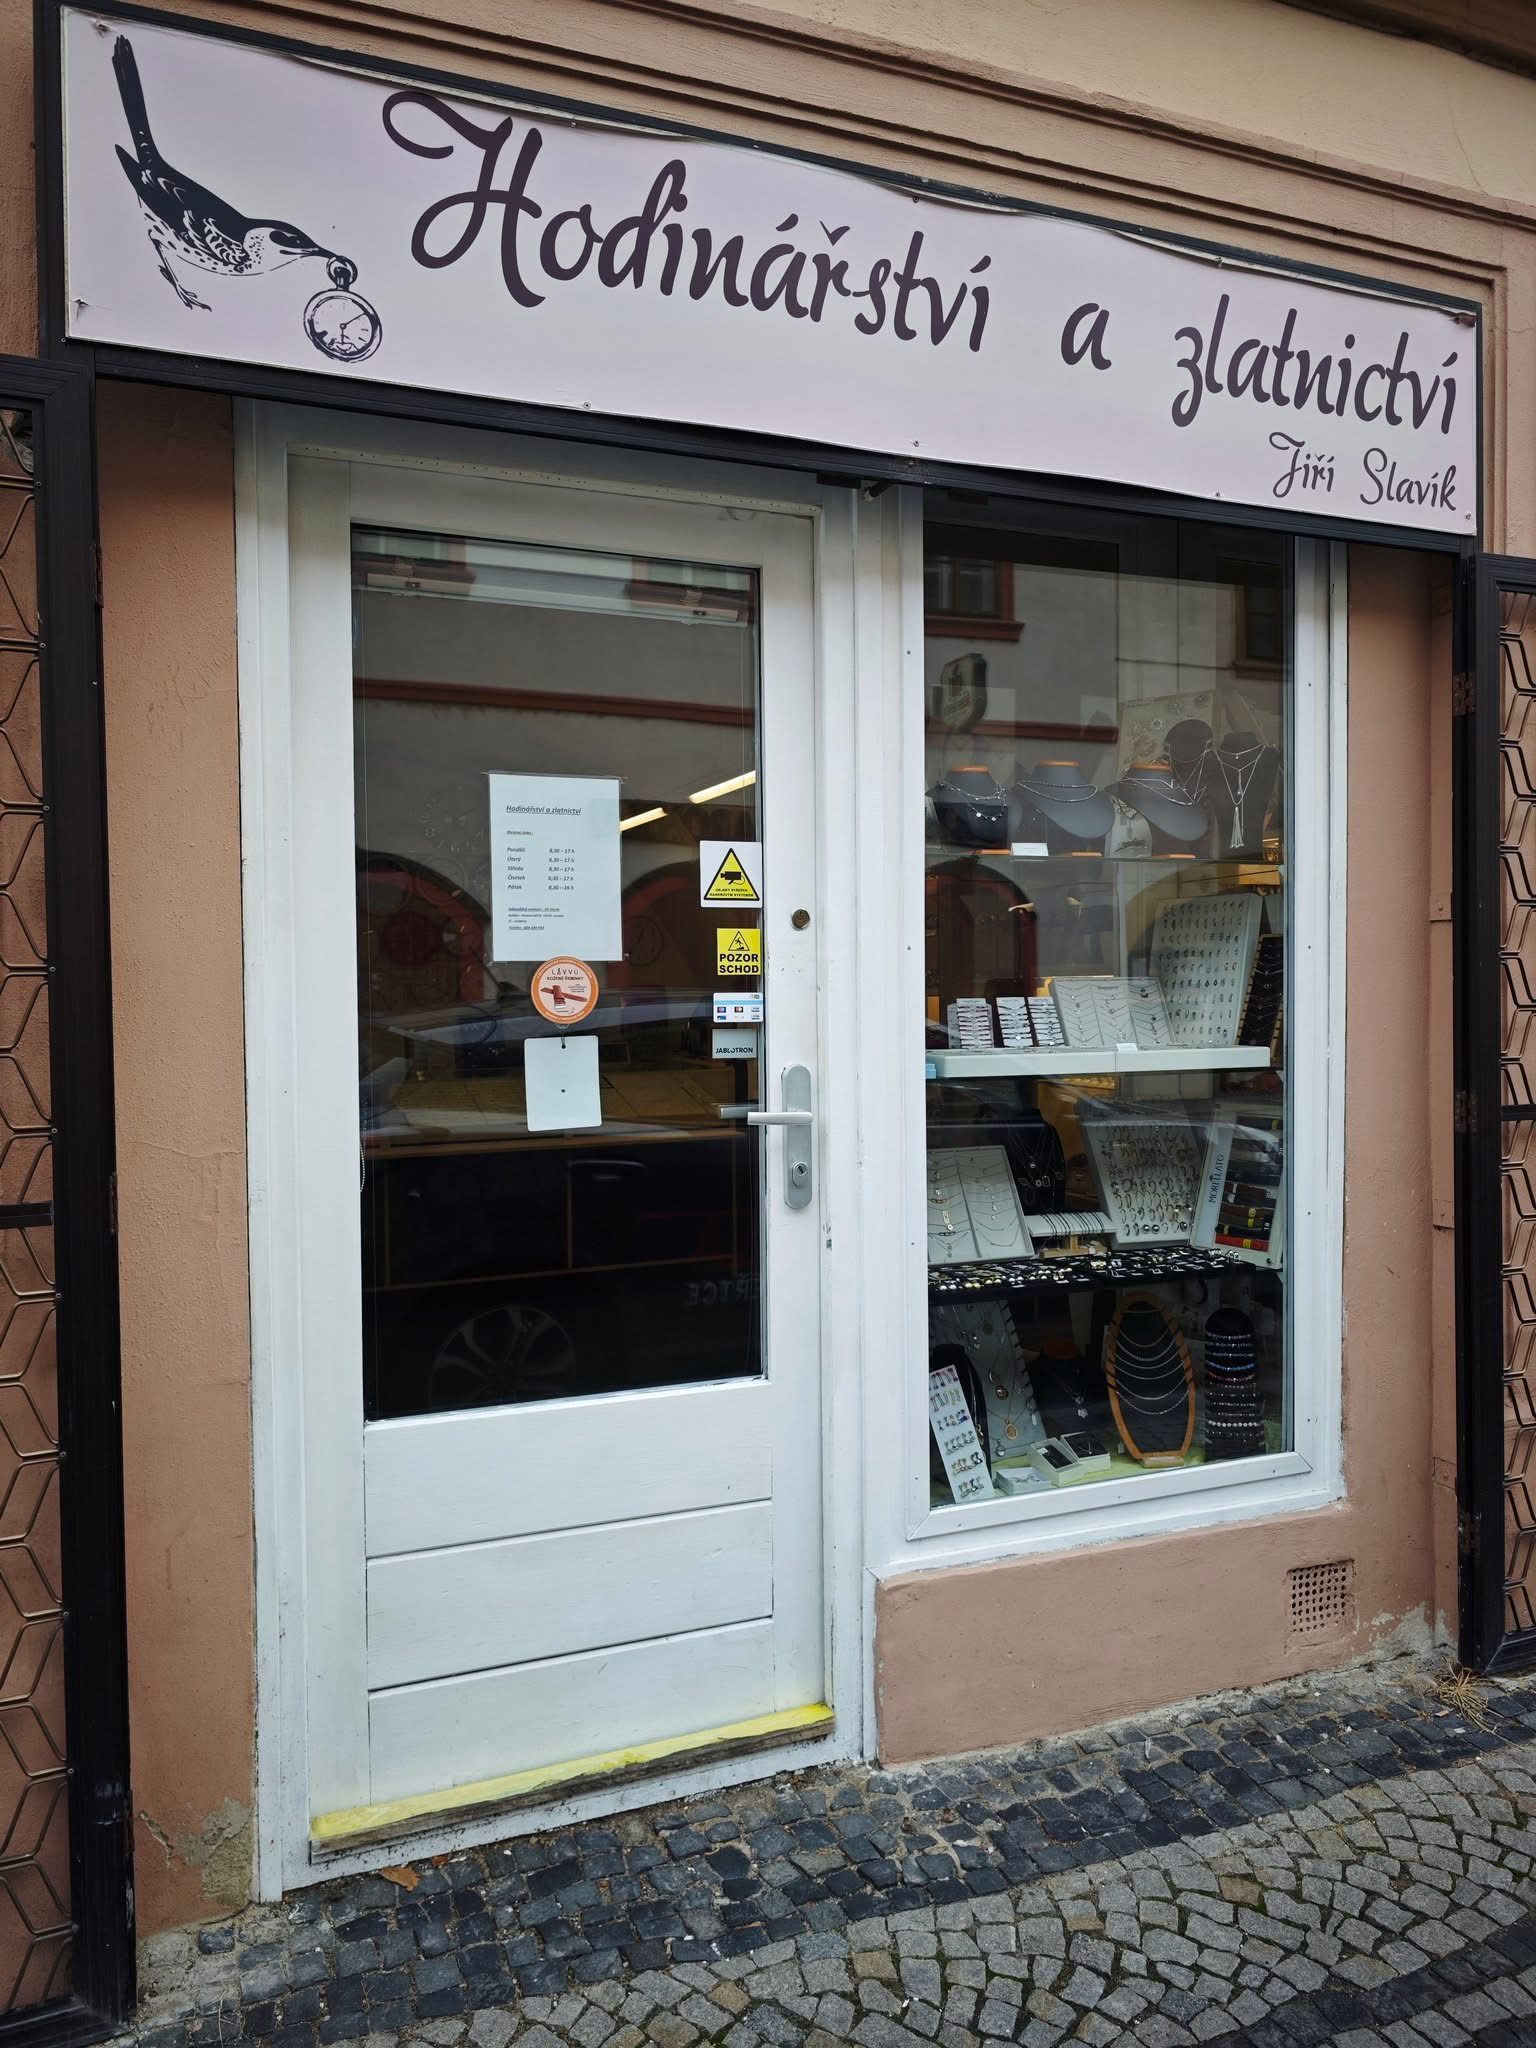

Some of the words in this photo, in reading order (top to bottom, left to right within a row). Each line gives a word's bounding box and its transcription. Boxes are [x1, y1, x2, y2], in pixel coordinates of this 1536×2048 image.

[382, 91, 992, 353] Hodinářství
[1061, 302, 1112, 370] a
[1171, 293, 1458, 434] zlatnictví
[1269, 431, 1335, 498] Jiří
[1359, 447, 1457, 511] Slavík
[719, 964, 759, 973] SCHOD
[720, 953, 759, 962] POZOR
[1208, 1154, 1225, 1203] MORELLATO
